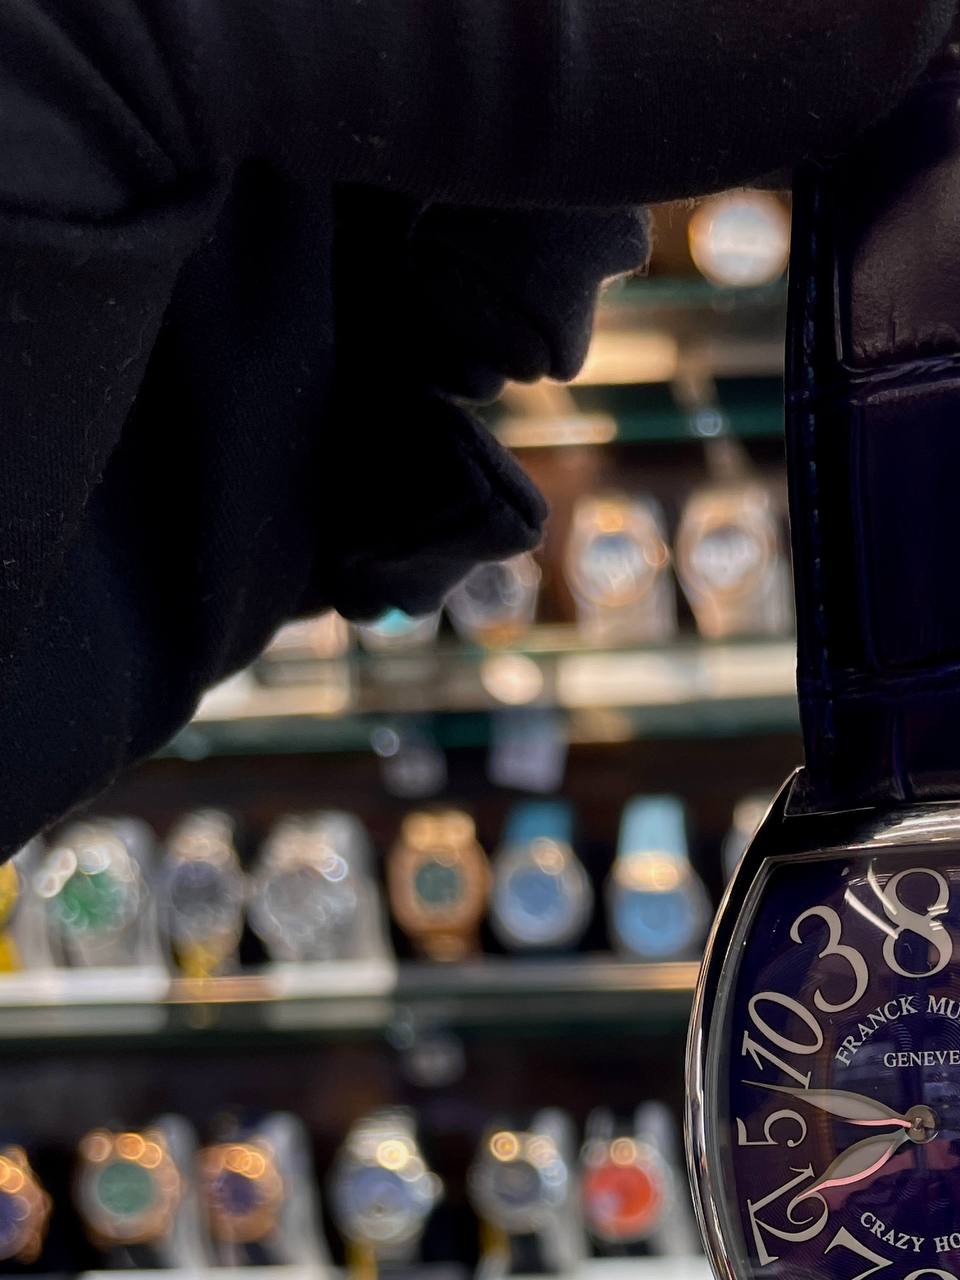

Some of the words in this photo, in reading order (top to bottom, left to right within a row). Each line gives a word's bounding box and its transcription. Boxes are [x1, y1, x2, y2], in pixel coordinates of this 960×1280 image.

[789, 905, 870, 1013] 3
[882, 867, 953, 978] 8
[741, 991, 824, 1090] 10
[835, 995, 918, 1067] FRANCK
[883, 1049, 960, 1068] GENEVE
[736, 1108, 807, 1148] 5
[746, 1162, 829, 1267] 12
[860, 1211, 925, 1253] CRAZY
